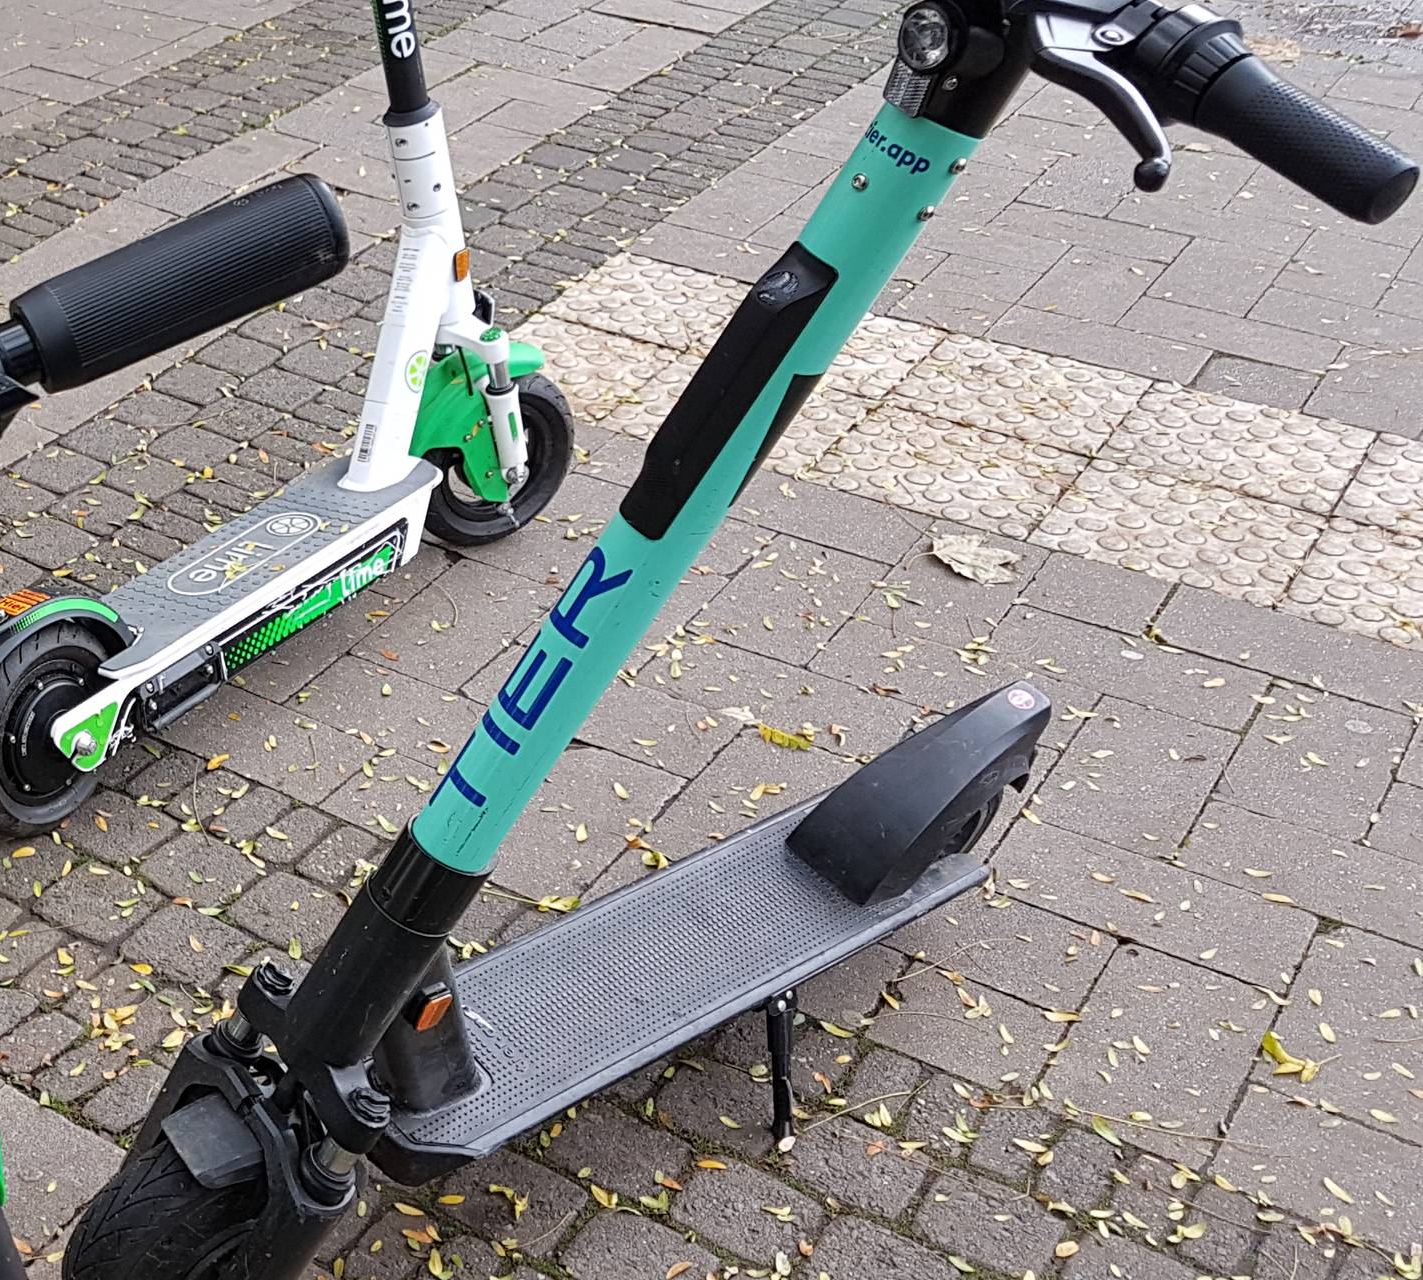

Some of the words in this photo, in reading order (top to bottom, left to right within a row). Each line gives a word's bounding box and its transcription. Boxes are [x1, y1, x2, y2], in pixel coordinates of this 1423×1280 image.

[864, 121, 931, 175] ier.app
[0, 598, 26, 613] Hier
[429, 546, 633, 807] TIER
